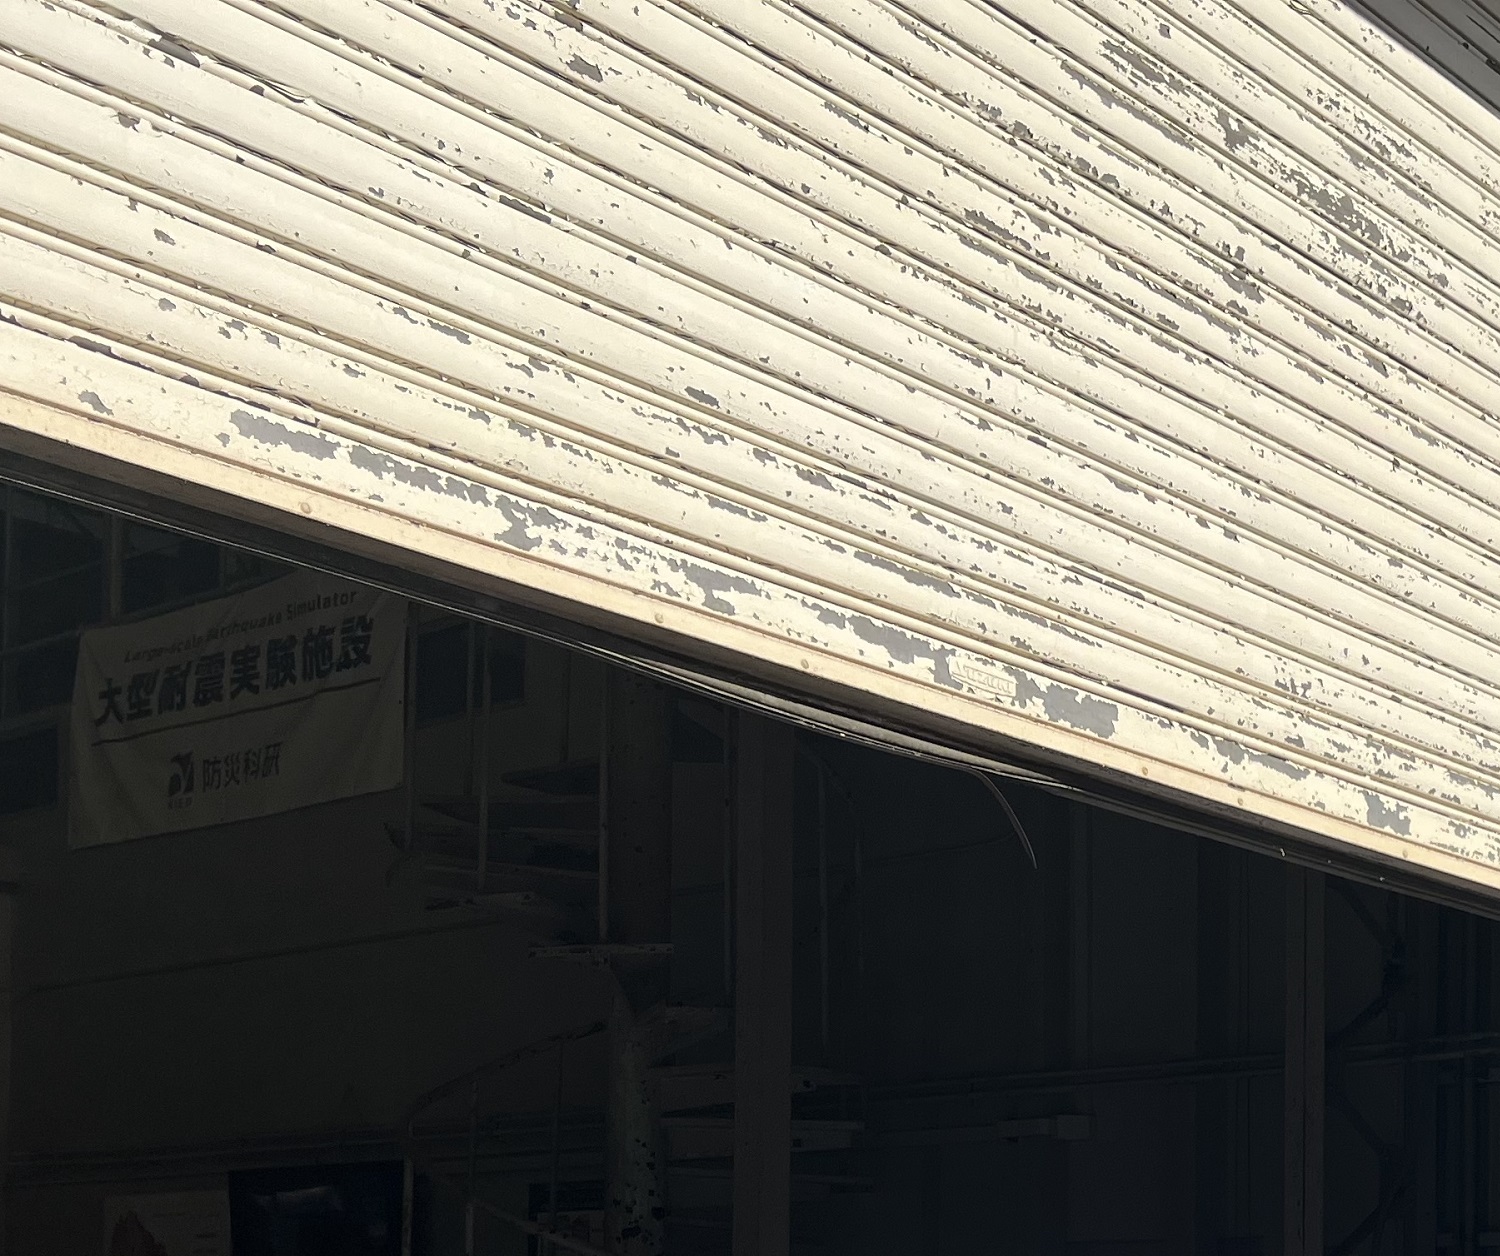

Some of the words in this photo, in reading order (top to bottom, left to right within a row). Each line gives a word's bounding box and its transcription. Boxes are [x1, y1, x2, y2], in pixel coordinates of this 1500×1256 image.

[286, 590, 358, 621] Simulator
[94, 615, 375, 727] 大型耐震実験施設
[202, 742, 283, 792] 防災科研
